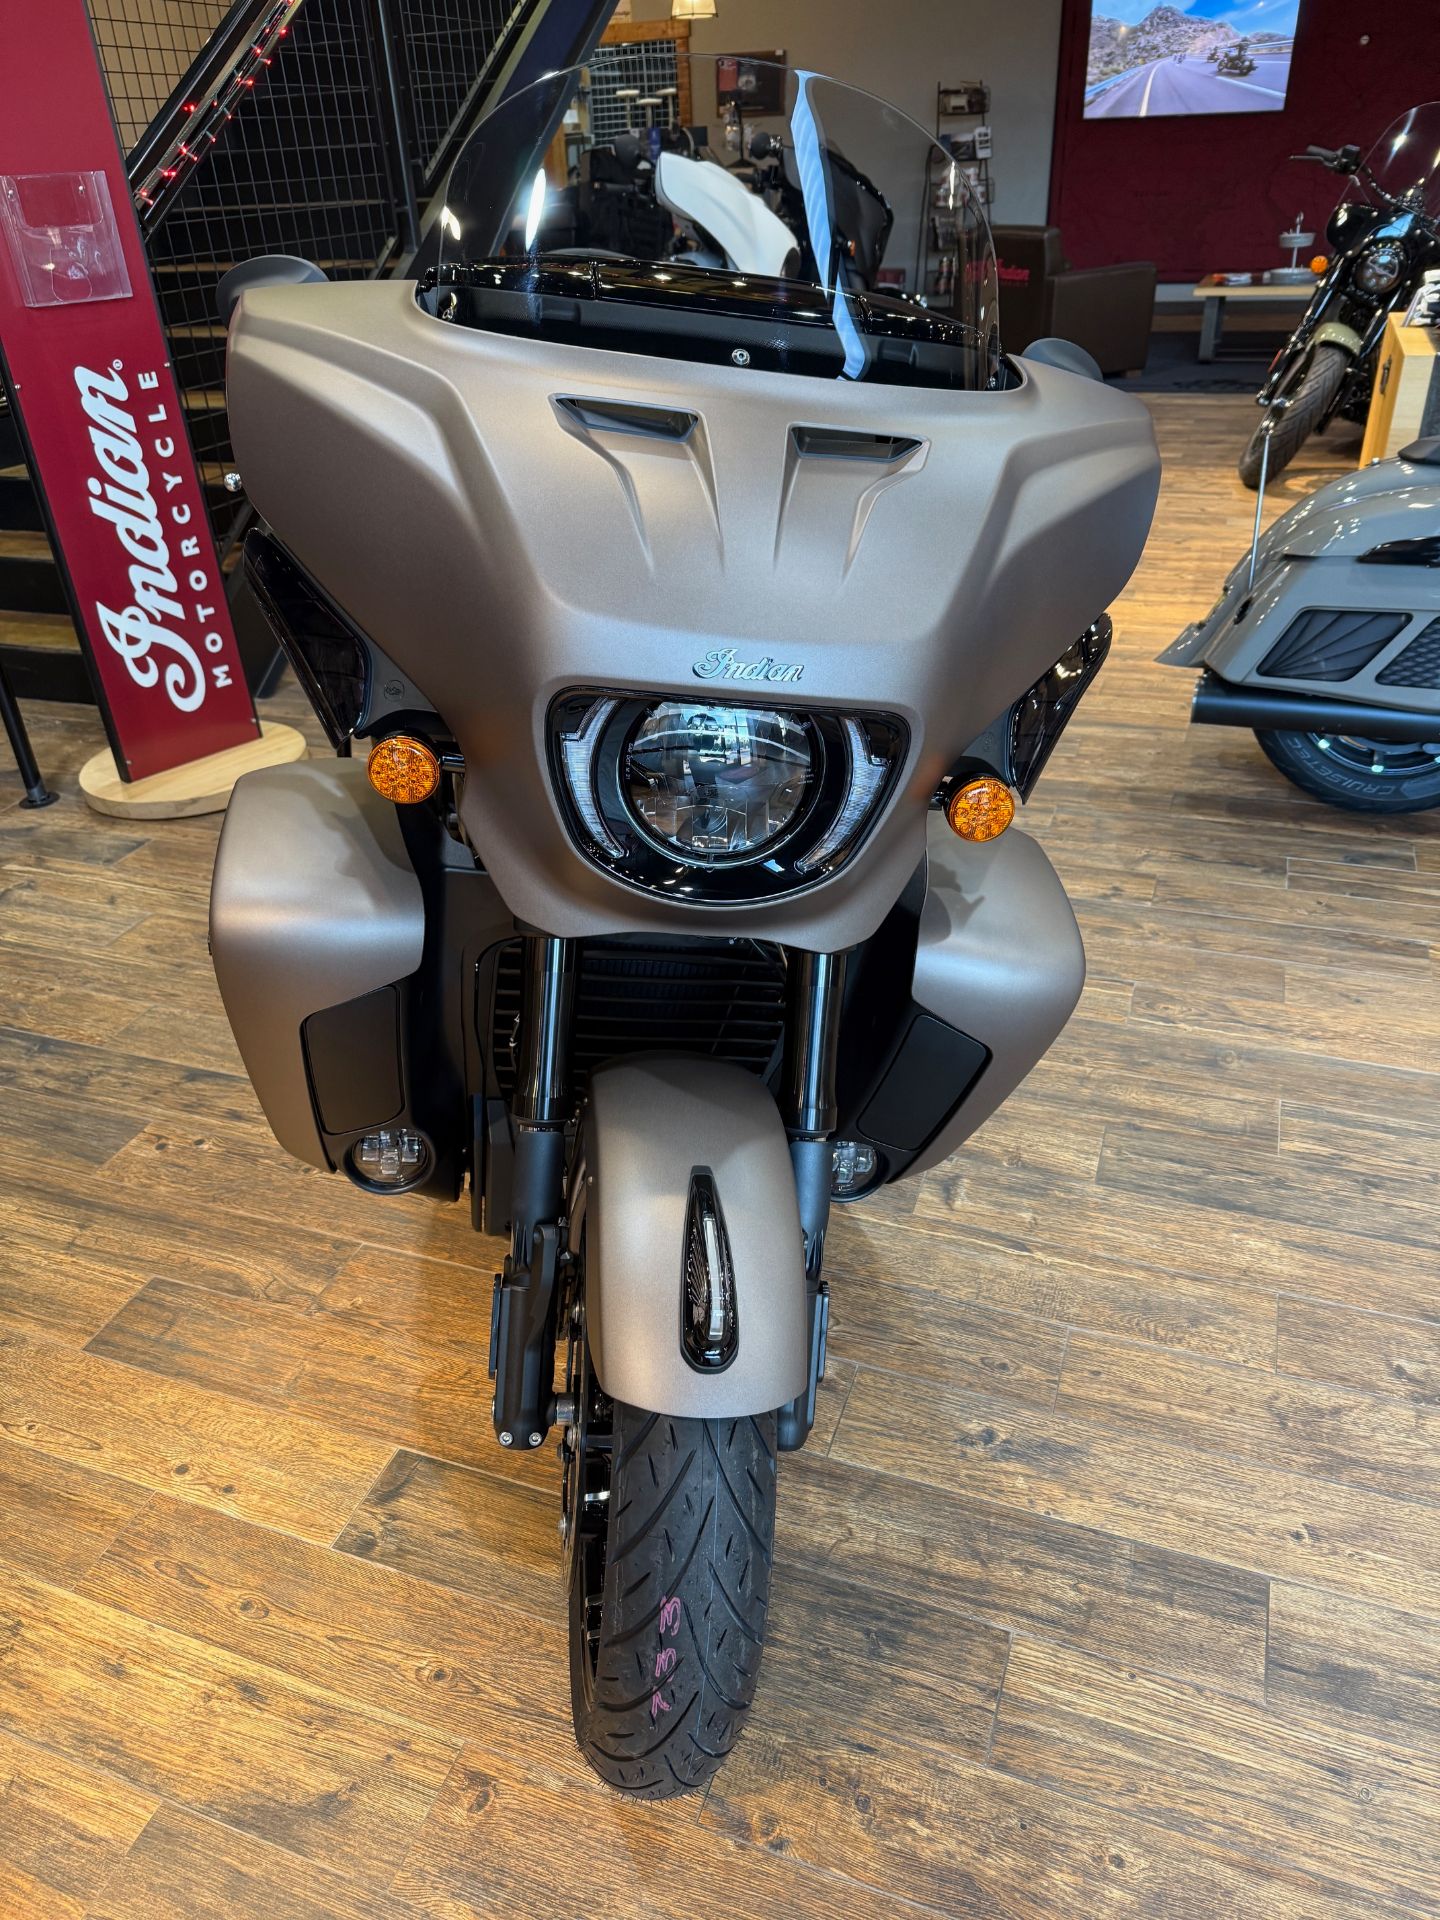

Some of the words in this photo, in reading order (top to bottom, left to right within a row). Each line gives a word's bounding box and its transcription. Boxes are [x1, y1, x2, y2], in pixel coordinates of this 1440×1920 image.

[74, 365, 206, 713] Indian
[137, 371, 233, 689] MOTORCYCLE
[692, 648, 805, 682] Indian
[1287, 737, 1397, 796] CRUISETEC
